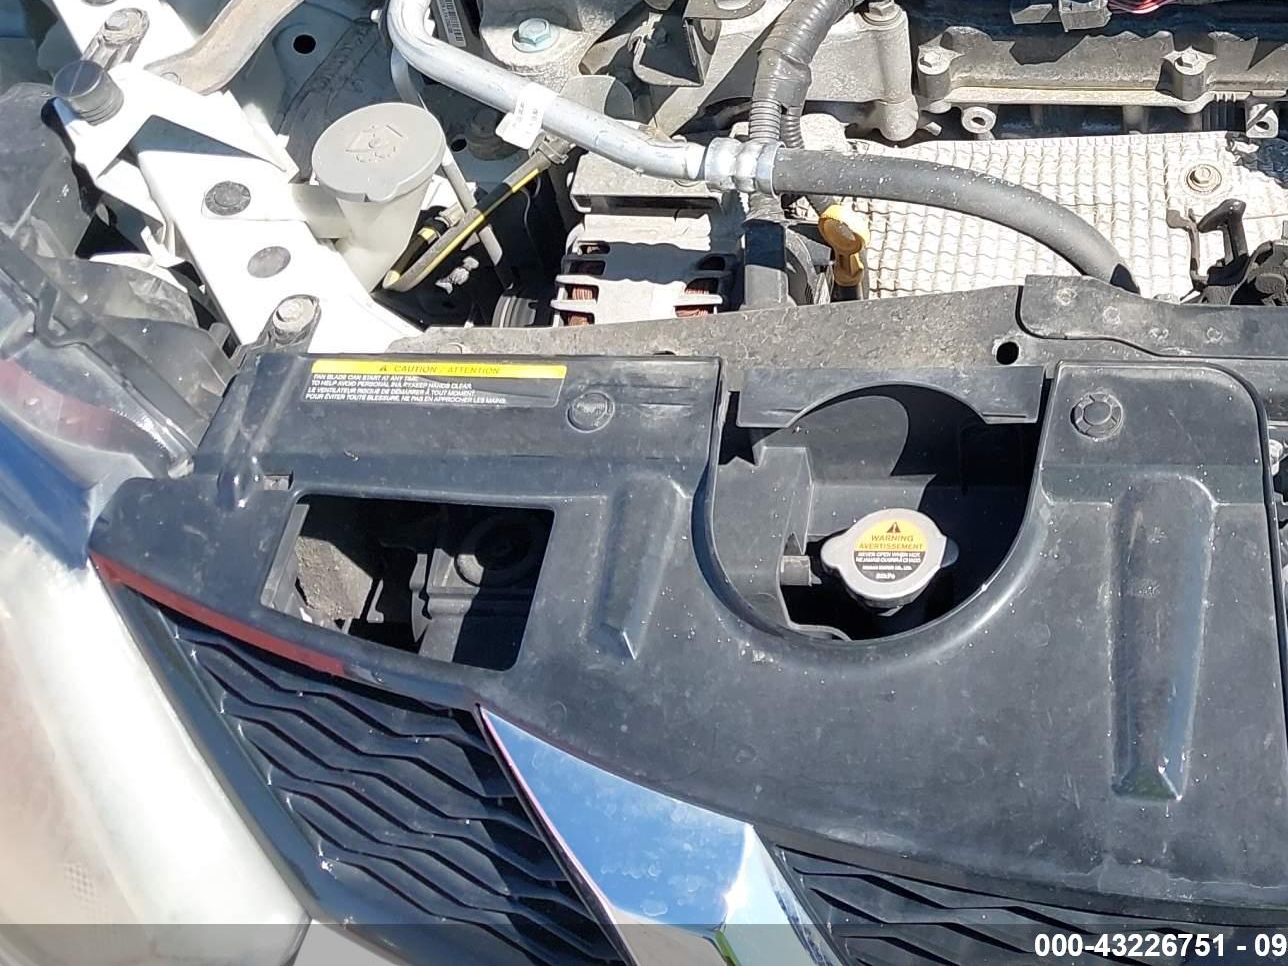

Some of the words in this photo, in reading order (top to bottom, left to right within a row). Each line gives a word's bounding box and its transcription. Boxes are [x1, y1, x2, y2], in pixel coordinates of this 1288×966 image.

[394, 365, 437, 373] CAUTION
[448, 366, 500, 374] ATTENTION
[871, 534, 914, 542] WARNING
